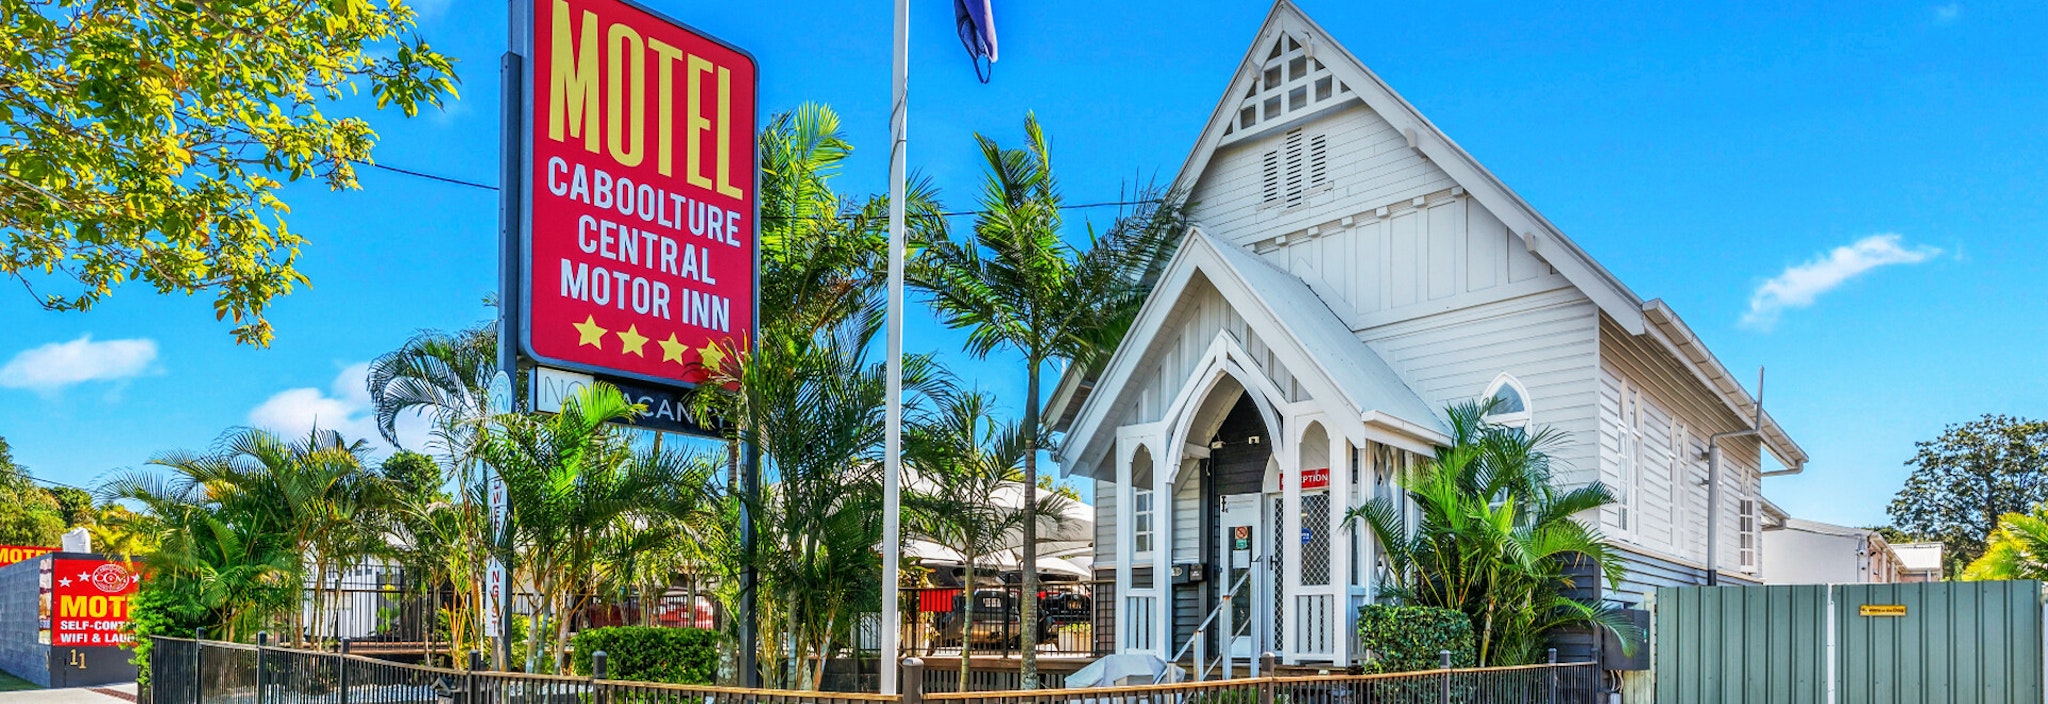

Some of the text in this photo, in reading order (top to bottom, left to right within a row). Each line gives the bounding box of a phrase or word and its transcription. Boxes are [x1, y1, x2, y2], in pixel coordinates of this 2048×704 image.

[548, 0, 743, 201] MOTEL
[547, 156, 741, 248] CABOOLTURE
[578, 214, 716, 286] CENTRAL
[560, 258, 730, 333] MOTOR INN
[623, 391, 728, 429] ACANY
[1282, 473, 1328, 485] PTION
[493, 479, 502, 533] OWER
[61, 595, 138, 618] MOTE
[61, 633, 88, 643] WIFI
[91, 633, 101, 643] &
[69, 649, 87, 669] 11
